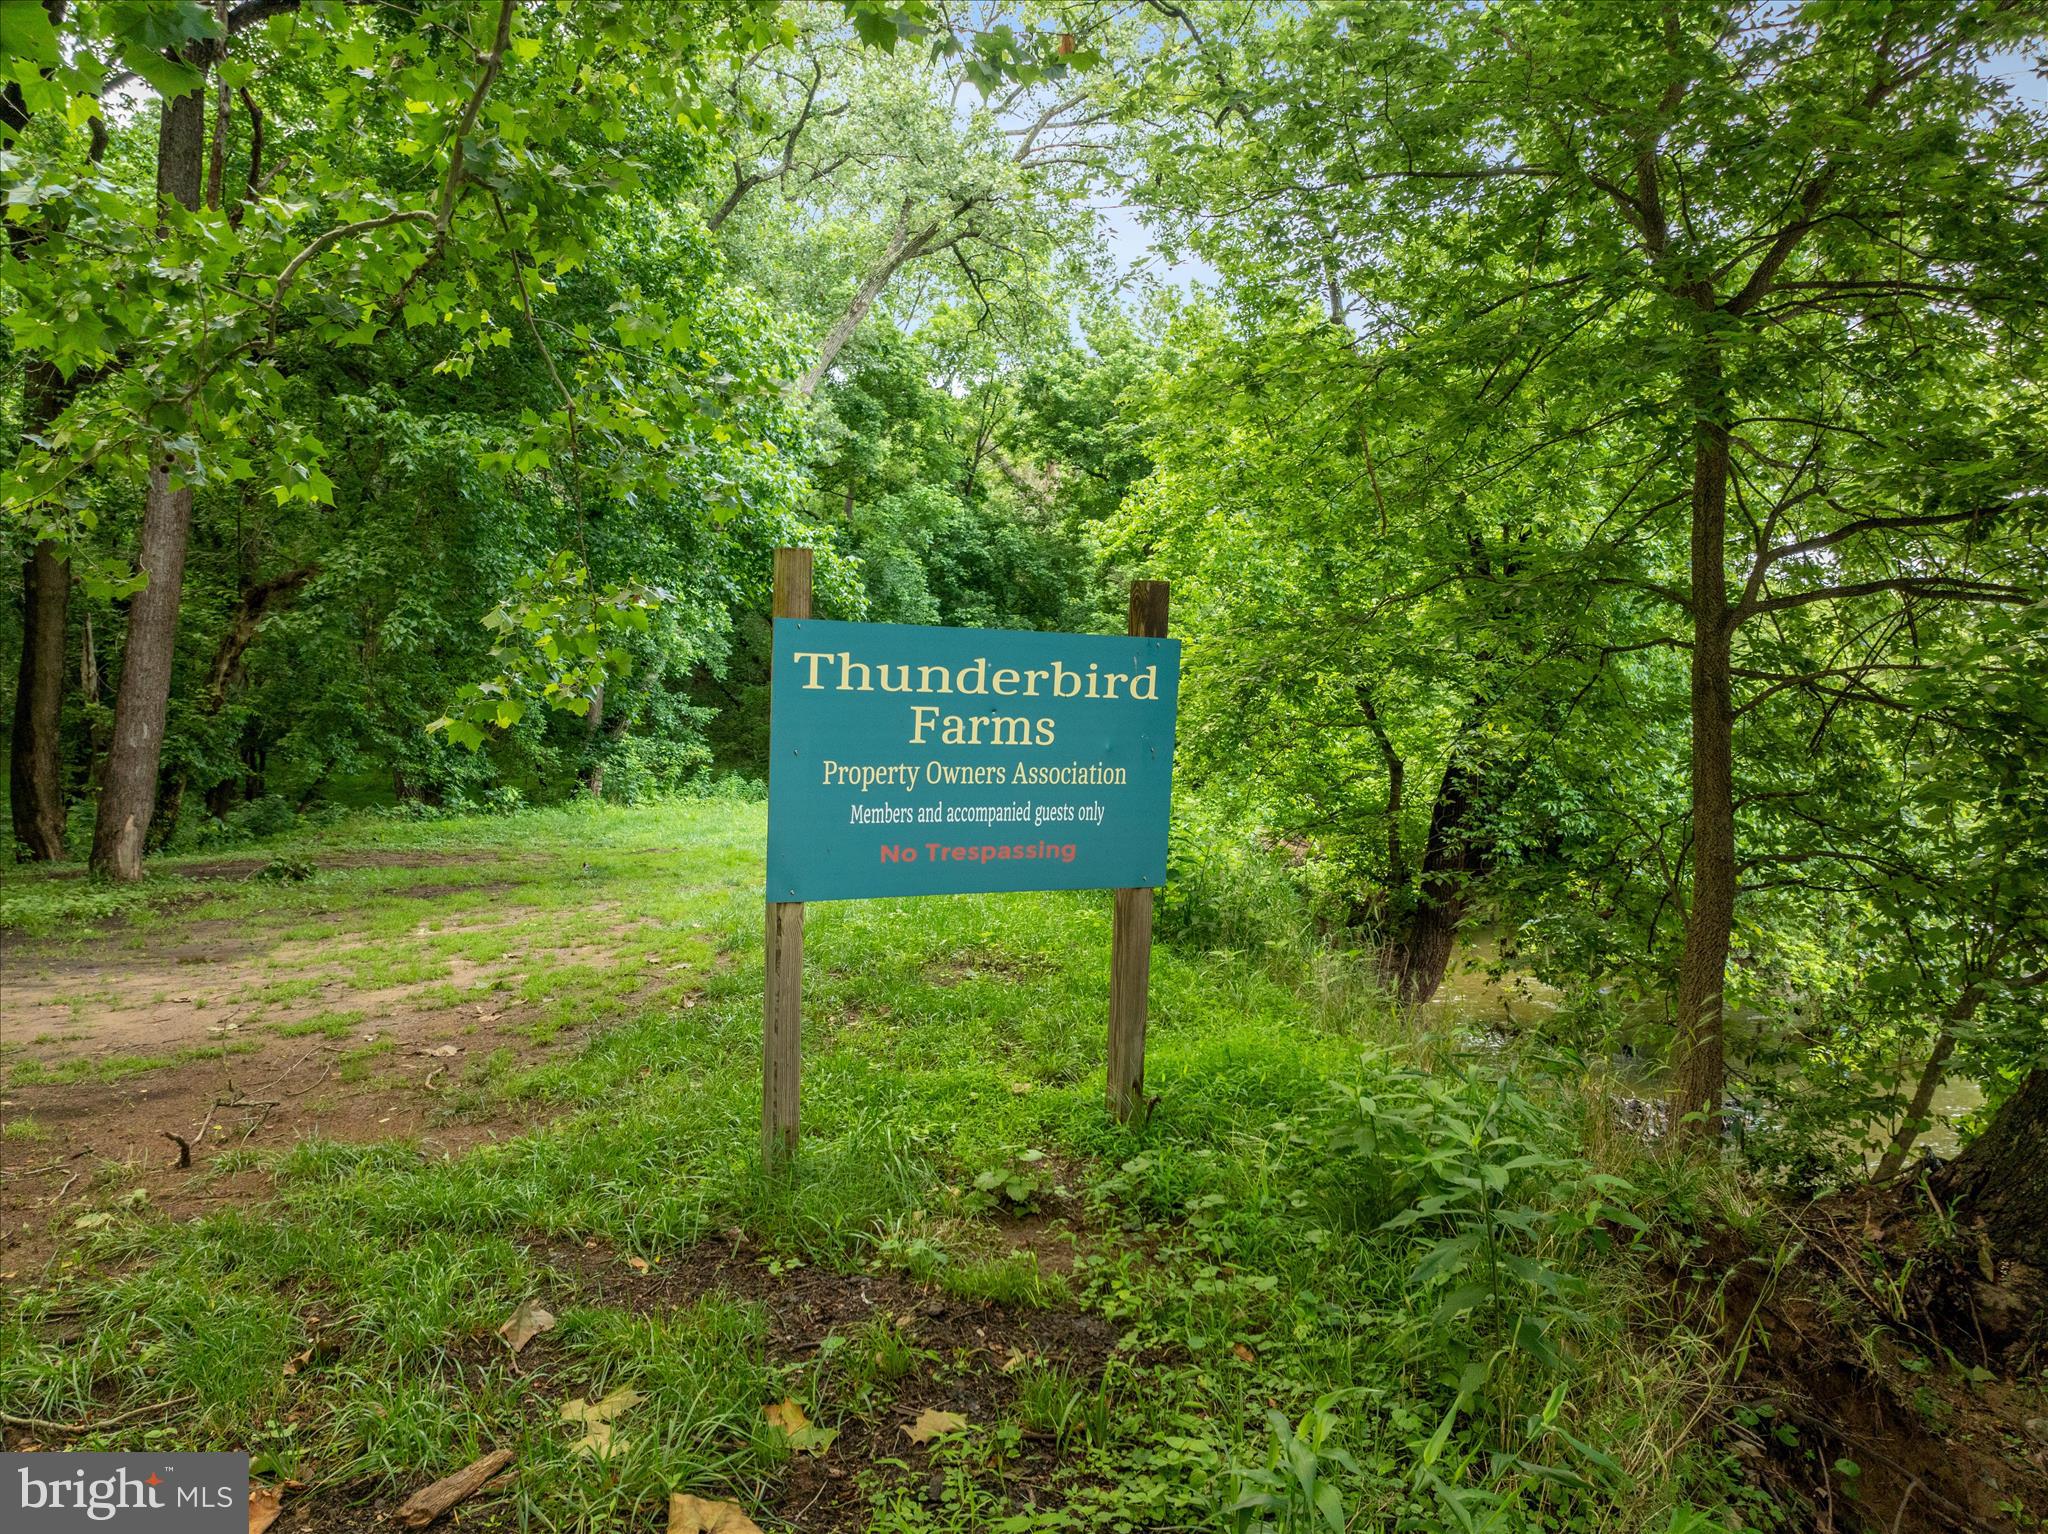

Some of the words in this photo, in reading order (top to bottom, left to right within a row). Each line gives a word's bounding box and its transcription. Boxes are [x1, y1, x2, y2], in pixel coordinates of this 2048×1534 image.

[793, 652, 1159, 700] Thunderbird
[909, 706, 1056, 746] Farms
[822, 760, 920, 792] Property
[926, 761, 1006, 785] Owners
[1011, 761, 1127, 785] Association
[850, 802, 914, 825] Members
[917, 801, 943, 823] and
[946, 801, 1031, 827] accompanied
[1034, 804, 1075, 826] guests
[1078, 801, 1105, 826] only
[880, 844, 918, 864] No
[925, 840, 1077, 864] Trespassing
